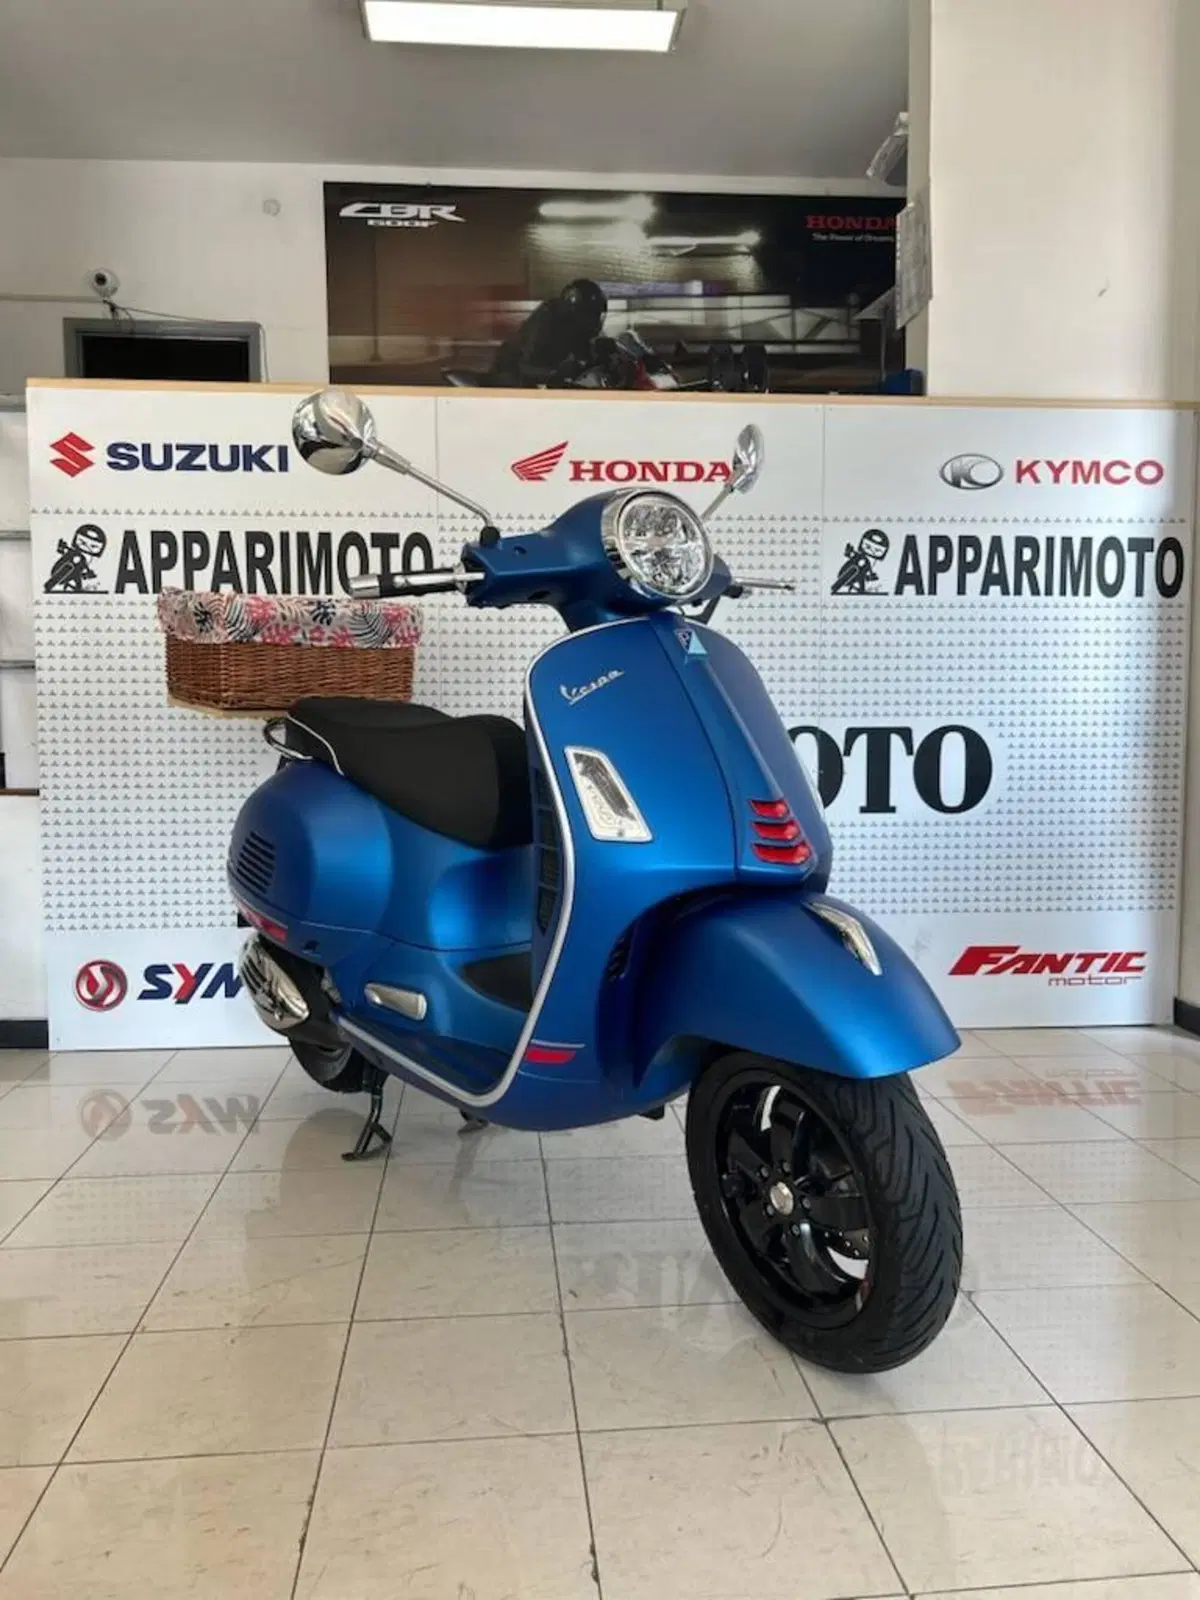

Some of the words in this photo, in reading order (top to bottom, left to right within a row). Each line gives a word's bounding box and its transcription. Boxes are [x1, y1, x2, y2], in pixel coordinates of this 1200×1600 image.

[339, 202, 466, 222] CBR
[106, 442, 289, 473] SUZUKI
[568, 460, 732, 483] HONDA
[1015, 459, 1165, 486] KYMCO
[114, 529, 435, 595] APPARIMOTO
[893, 534, 1185, 599] APPARIMOTO
[559, 669, 625, 705] Vespa
[947, 945, 1148, 976] FANTIC
[1048, 975, 1142, 987] motor
